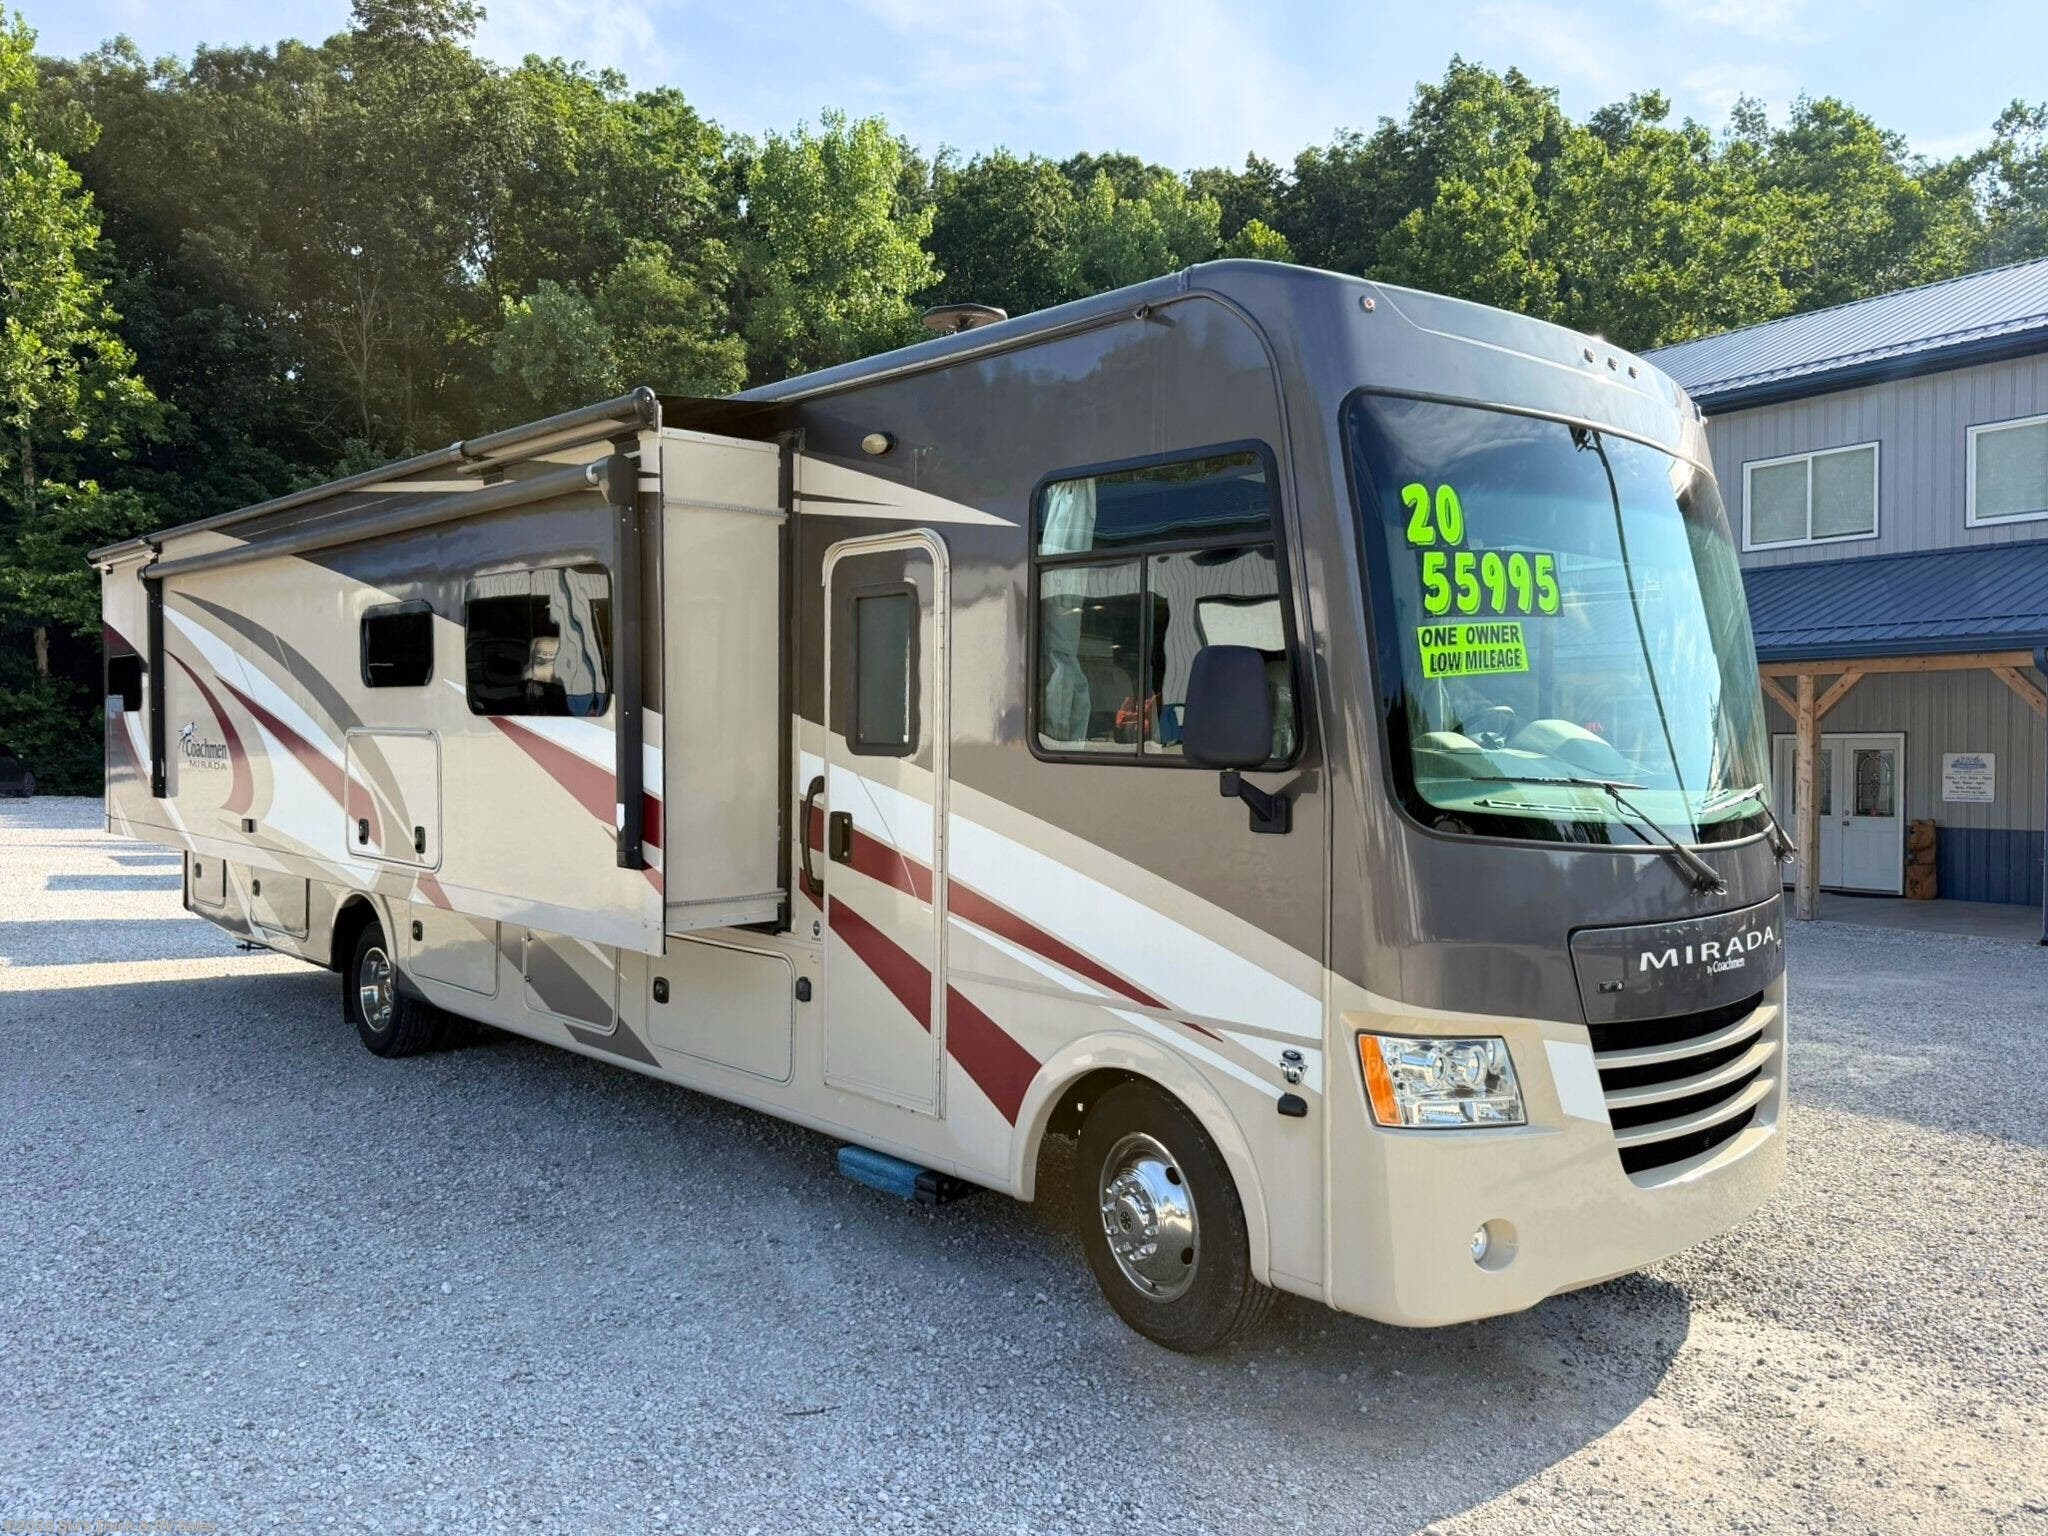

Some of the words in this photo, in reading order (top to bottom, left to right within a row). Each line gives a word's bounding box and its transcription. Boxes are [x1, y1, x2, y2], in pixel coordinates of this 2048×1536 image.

[1401, 483, 1463, 545] 20
[1422, 551, 1559, 615] 55995
[1421, 626, 1458, 648] ONE
[1465, 624, 1521, 645] OWNER
[1430, 651, 1462, 673] LOW
[1465, 648, 1521, 672] MILEAGE
[186, 738, 227, 759] Coachmen
[189, 760, 227, 770] MIRADA
[1639, 925, 1775, 973] MIRADA
[1712, 956, 1746, 974] Coachmen
